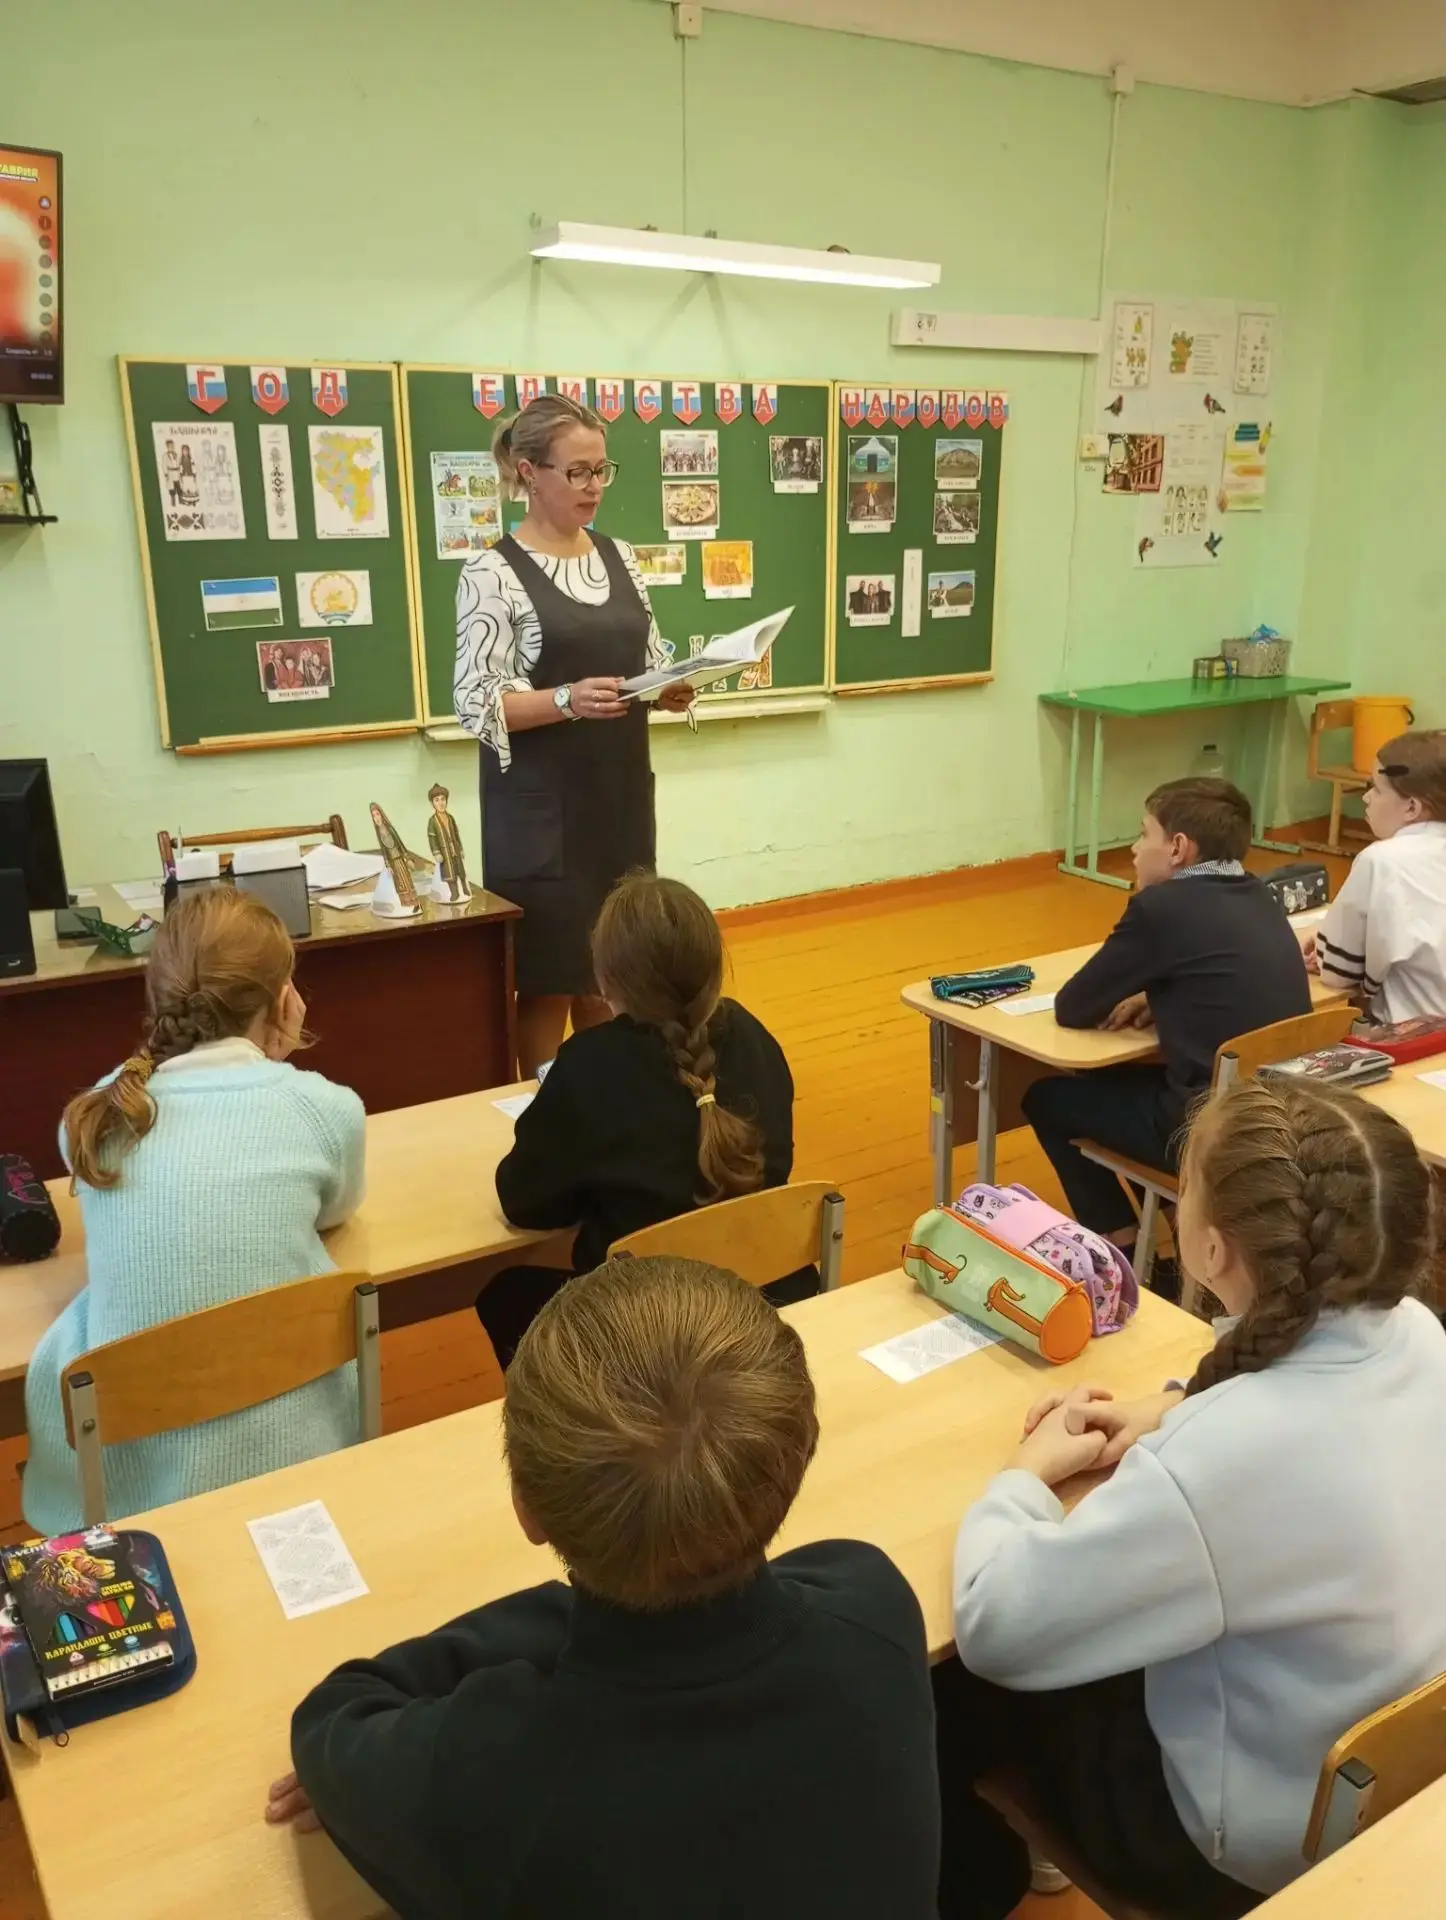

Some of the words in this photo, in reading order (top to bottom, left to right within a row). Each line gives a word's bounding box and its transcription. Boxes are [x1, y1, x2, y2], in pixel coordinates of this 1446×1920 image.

[196, 370, 343, 407] ГОД
[844, 392, 1004, 419] НАРОДОВ
[45, 1635, 106, 1660] КАРАНДАШИ
[108, 1622, 153, 1640] ЦВЕТНЫЕ
